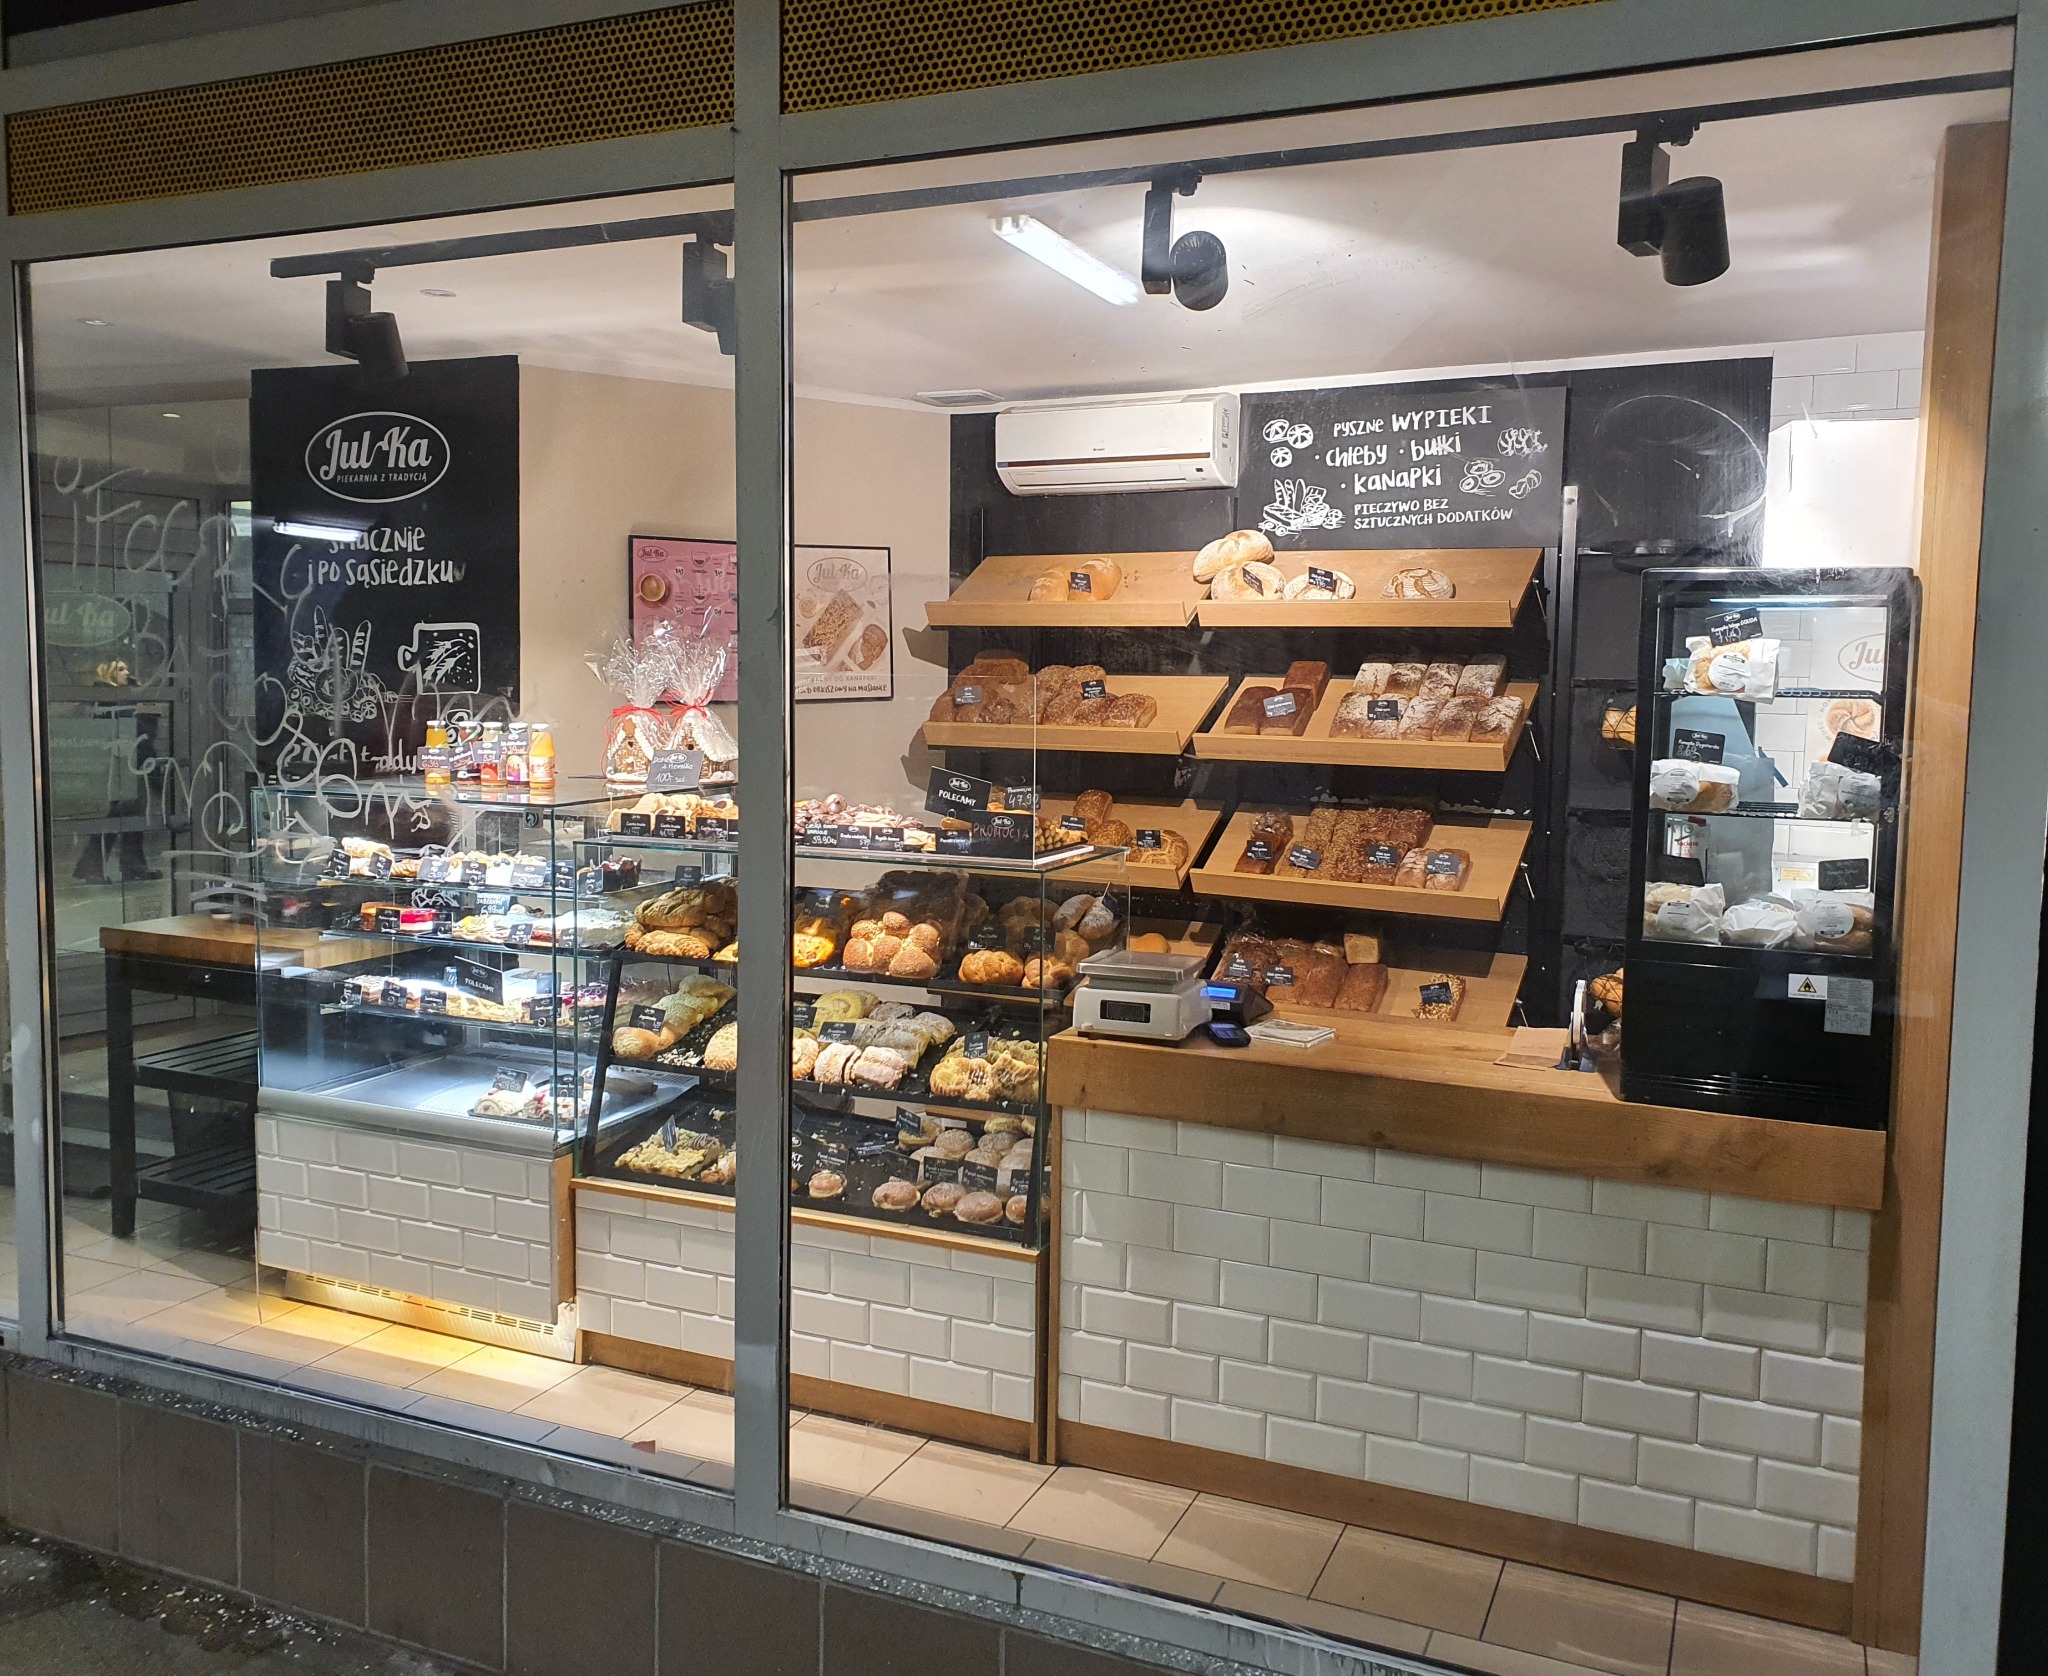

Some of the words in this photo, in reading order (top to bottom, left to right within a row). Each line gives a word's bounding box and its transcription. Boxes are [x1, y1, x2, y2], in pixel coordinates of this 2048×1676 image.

[1392, 405, 1492, 432] WYPIEKI
[336, 474, 378, 483] PIEKARNIA
[380, 473, 386, 482] Z
[389, 472, 427, 482] TRADYCJĄ
[1354, 500, 1420, 516] PIECZYWO
[1423, 498, 1449, 511] BEZ
[1353, 513, 1434, 530] SZTUCZNYCH
[1437, 506, 1514, 524] DODATKÓW
[938, 789, 977, 807] POLECAMY
